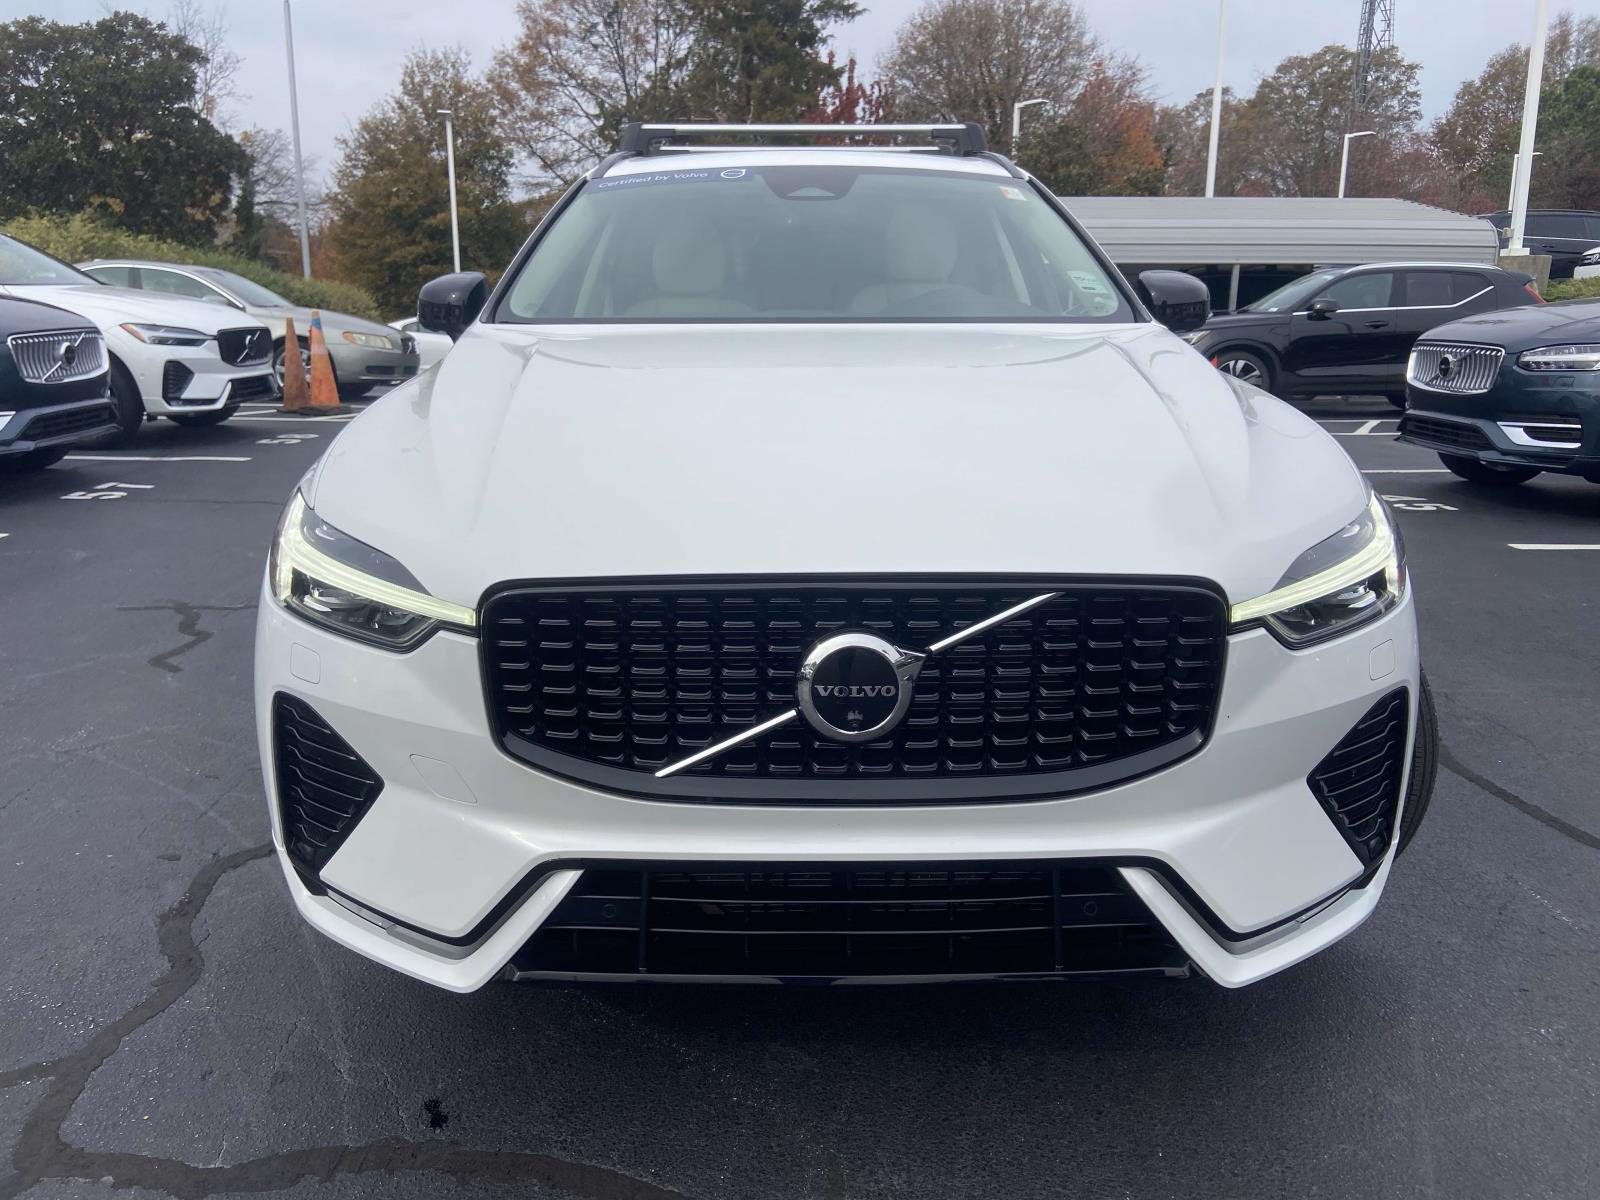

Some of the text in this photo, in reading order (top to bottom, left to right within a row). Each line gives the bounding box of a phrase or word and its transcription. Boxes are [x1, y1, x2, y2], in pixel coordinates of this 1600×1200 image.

[598, 177, 652, 189] Certified
[654, 174, 670, 182] by
[814, 685, 897, 697] VOLVO
